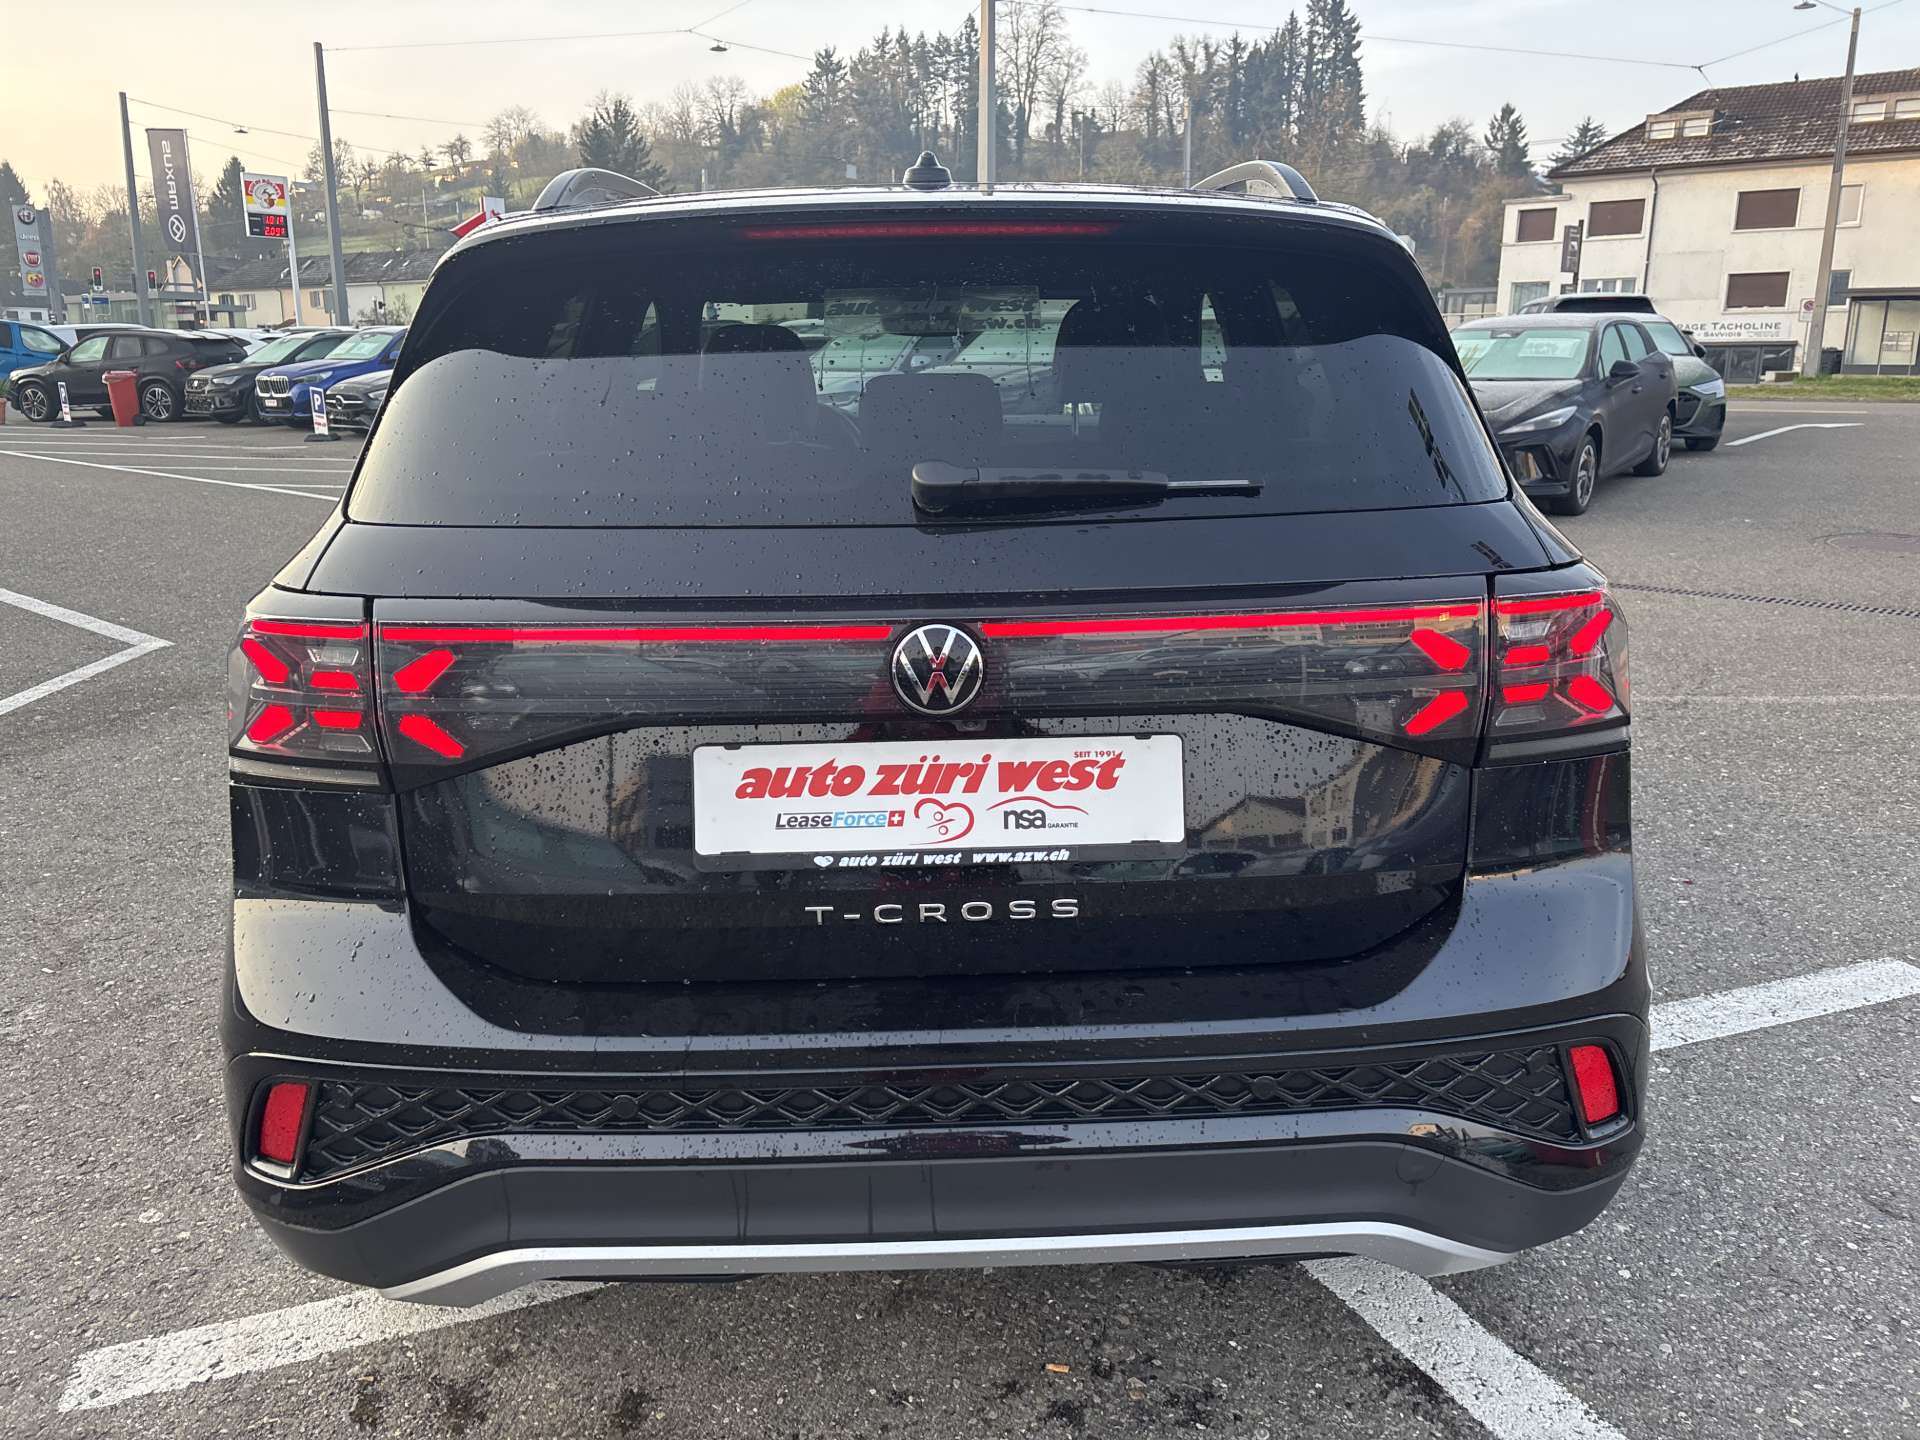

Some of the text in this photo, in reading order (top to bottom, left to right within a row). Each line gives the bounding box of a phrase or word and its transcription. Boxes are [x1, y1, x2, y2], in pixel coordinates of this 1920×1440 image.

[1711, 321, 1782, 331] TACHOLINE
[313, 393, 321, 411] P
[1073, 750, 1117, 759] SEIT 1991
[735, 751, 1126, 799] auto züri west
[775, 811, 888, 829] LeaseForce
[1003, 809, 1047, 829] nsa
[838, 849, 1071, 867] auto züri west www.azw.ch
[804, 898, 1079, 926] T-CROSS
